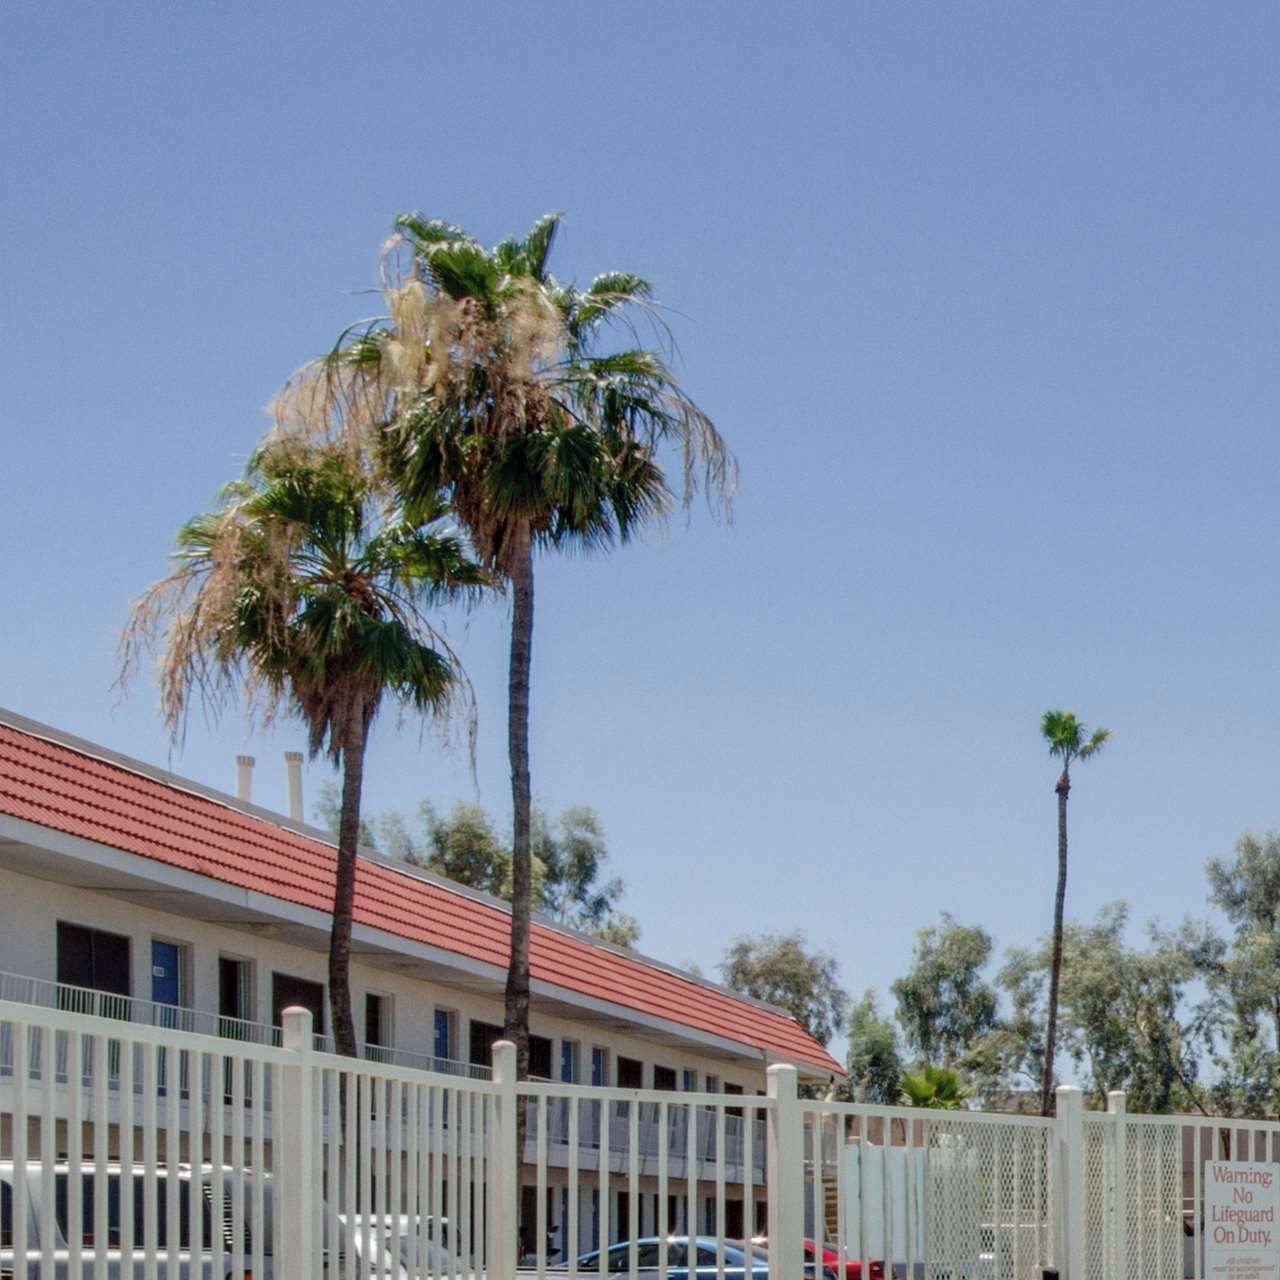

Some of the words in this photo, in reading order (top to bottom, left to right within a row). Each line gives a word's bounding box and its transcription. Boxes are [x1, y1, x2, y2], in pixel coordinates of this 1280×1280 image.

[1233, 1187, 1253, 1204] No
[1212, 1205, 1274, 1225] Lifeguard
[1213, 1226, 1235, 1244] On
